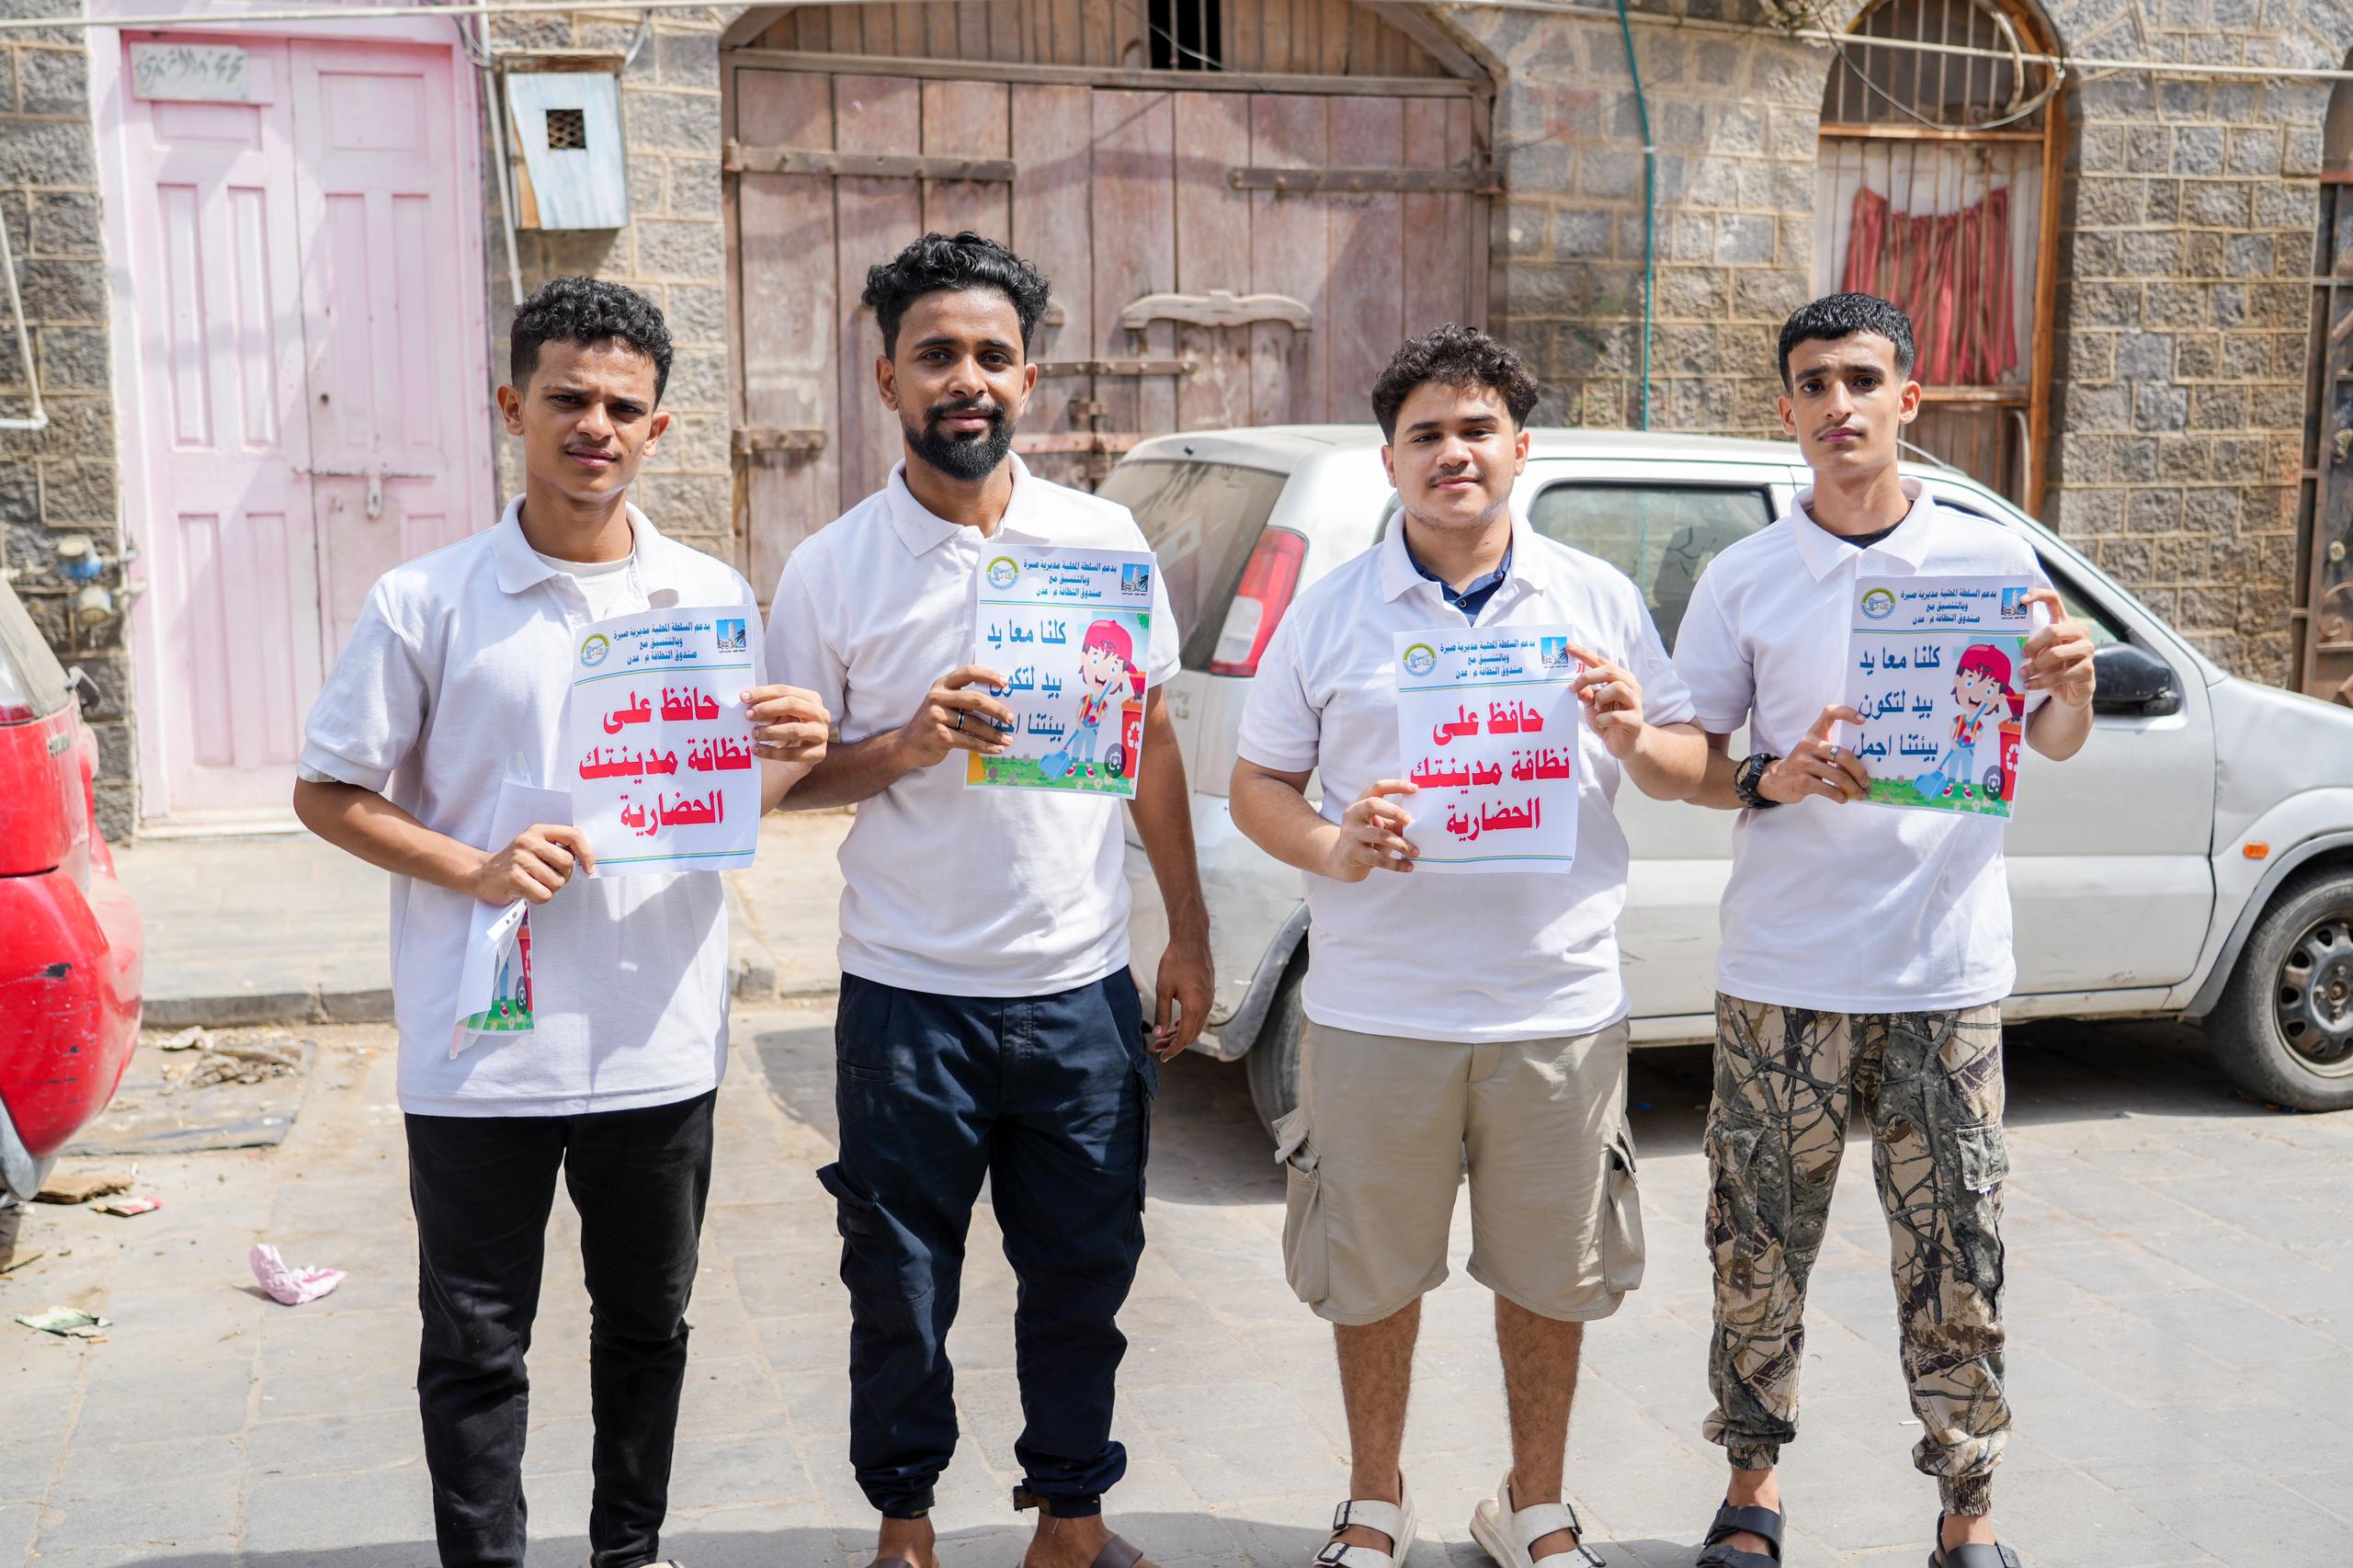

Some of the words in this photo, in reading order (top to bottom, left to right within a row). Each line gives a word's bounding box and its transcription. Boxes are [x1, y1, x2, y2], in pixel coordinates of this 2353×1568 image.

[1040, 560, 1060, 571] مديرية
[1081, 561, 1101, 571] السلطة
[1102, 564, 1117, 574] بدعم
[1049, 575, 1057, 584] مع
[1080, 589, 1102, 598] صندوق
[1918, 589, 1938, 600] مديرية
[1960, 588, 1980, 597] السلطة
[1982, 591, 1996, 599] بدعم
[1927, 604, 1935, 612] مع
[1936, 614, 1956, 622] النظافة
[1958, 615, 1980, 624] صندوق
[672, 621, 693, 631] السلطة
[695, 623, 710, 634] بدعم
[1009, 619, 1033, 643] معا
[1040, 619, 1066, 644] كلنا
[631, 627, 650, 638] مديرية
[987, 621, 1002, 650] يد
[640, 642, 648, 651] مع
[1457, 642, 1477, 653] مديرية
[1498, 640, 1518, 649] السلطة
[1520, 640, 1535, 650] بدعم
[652, 651, 673, 660] النظافة
[675, 651, 697, 662] صندوق
[1468, 656, 1476, 665] مع
[1882, 647, 1906, 669] معا
[1915, 643, 1940, 668] كلنا
[1859, 649, 1874, 676] يد
[1480, 665, 1499, 676] النظافة
[1502, 666, 1523, 676] صندوق
[1041, 673, 1062, 699] بيد
[660, 687, 720, 722] حافظ
[1859, 689, 1906, 721] لتكون
[1912, 694, 1933, 719] بيد
[603, 690, 653, 734] على
[1487, 700, 1544, 734] حافظ
[1029, 713, 1064, 743] بيئتنا
[1433, 704, 1479, 745] على
[688, 735, 752, 772] نظافة
[1853, 733, 1892, 763] اجمل
[1900, 733, 1938, 763] بيئتنا
[579, 745, 678, 784] مدينتك
[1511, 746, 1570, 781] نظافة
[1410, 756, 1504, 794] مدينتك
[620, 789, 723, 836] الحضارية
[1447, 796, 1540, 842] الحضارية
